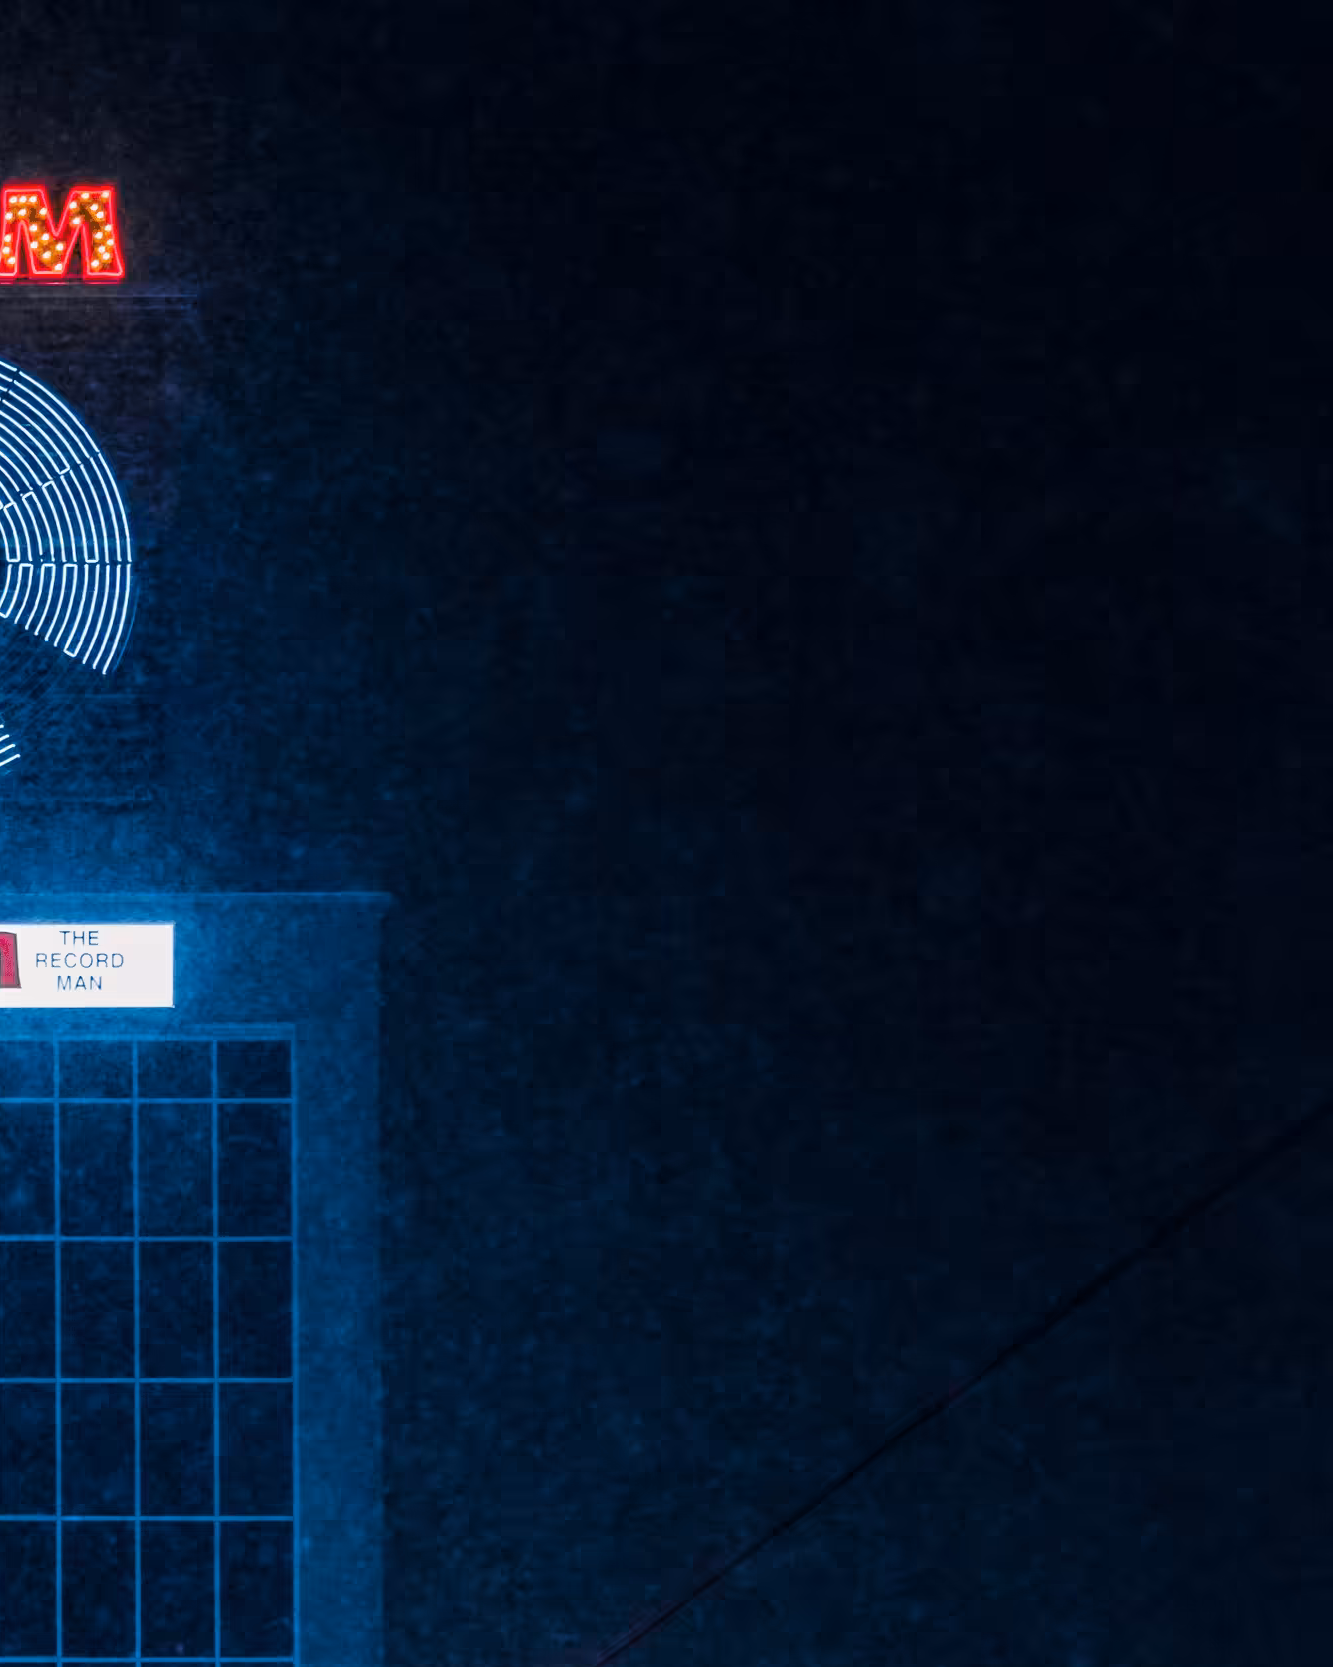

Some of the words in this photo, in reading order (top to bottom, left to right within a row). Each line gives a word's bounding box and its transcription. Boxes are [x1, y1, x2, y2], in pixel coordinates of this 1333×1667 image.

[59, 930, 100, 947] THE
[35, 951, 125, 969] RECORD
[56, 974, 104, 991] MAN
